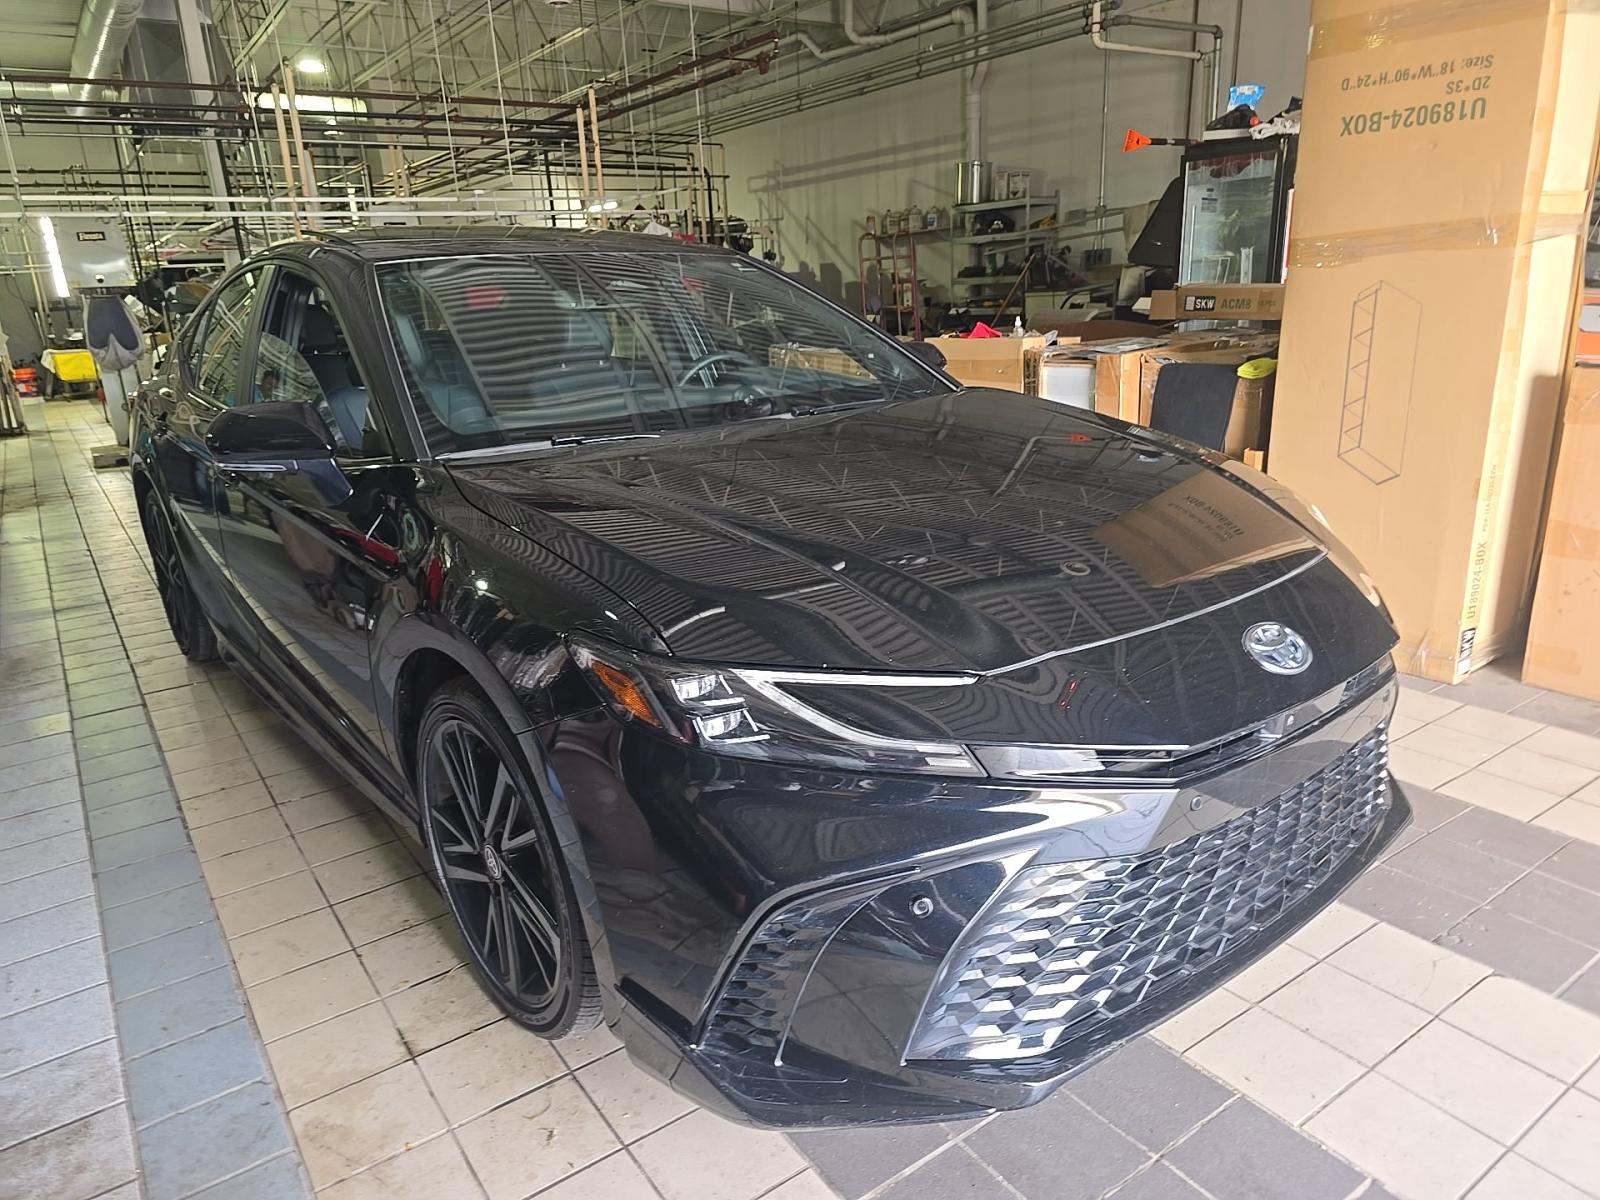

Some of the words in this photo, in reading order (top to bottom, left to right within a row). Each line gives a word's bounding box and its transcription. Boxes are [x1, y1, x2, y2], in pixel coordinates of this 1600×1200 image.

[1461, 54, 1494, 69] Size:
[1340, 97, 1487, 137] U189024-BOX
[1195, 299, 1215, 309] SKW
